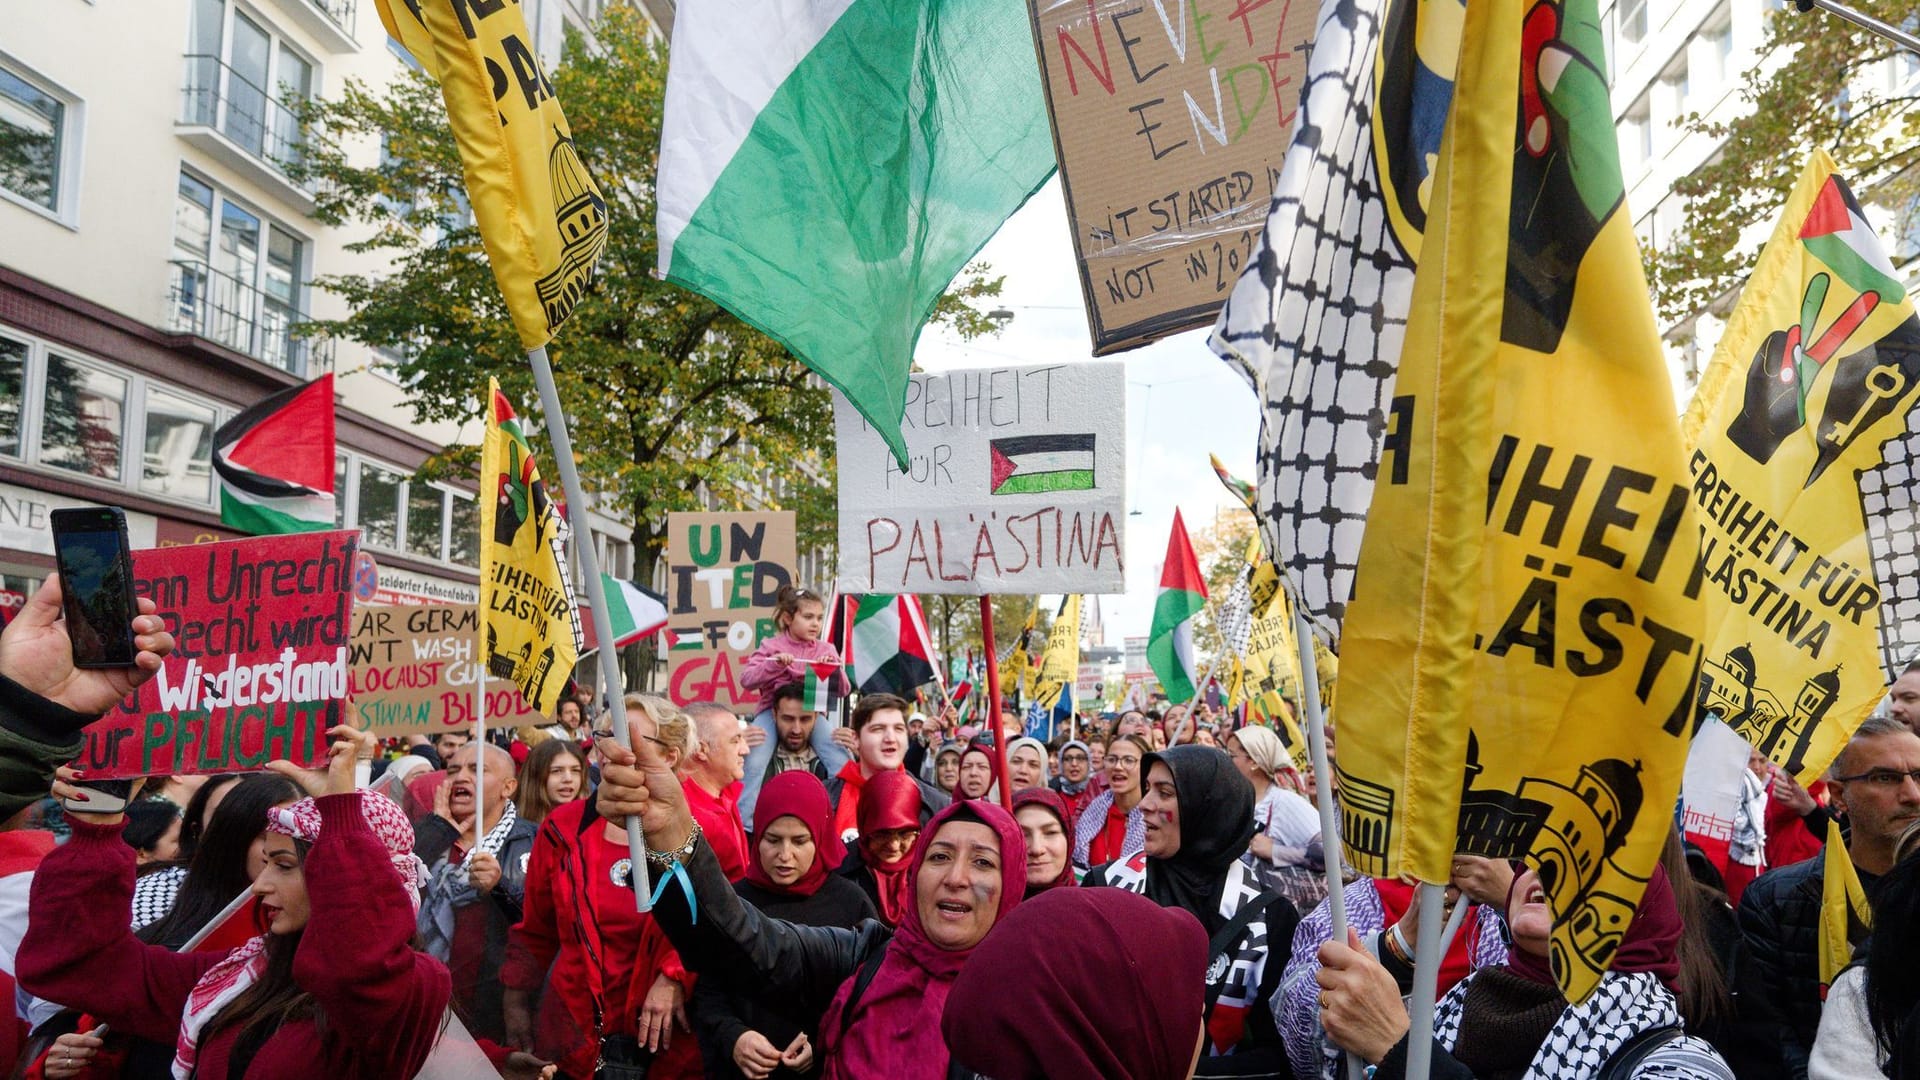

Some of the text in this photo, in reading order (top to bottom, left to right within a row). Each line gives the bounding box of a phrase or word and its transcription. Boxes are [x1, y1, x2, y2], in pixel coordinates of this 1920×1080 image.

[1148, 171, 1253, 232] STARTED
[1106, 259, 1164, 304] NOT
[862, 365, 1066, 431] REIHEIT
[131, 537, 360, 609] enn Unrecht
[688, 522, 766, 568] UN
[867, 506, 1124, 589] PALÄSTINA
[671, 561, 792, 615] ITED
[1699, 524, 1832, 660] LÄSTINA
[1799, 555, 1880, 626] FÜR
[407, 608, 481, 633] GERM
[412, 637, 472, 661] WASH
